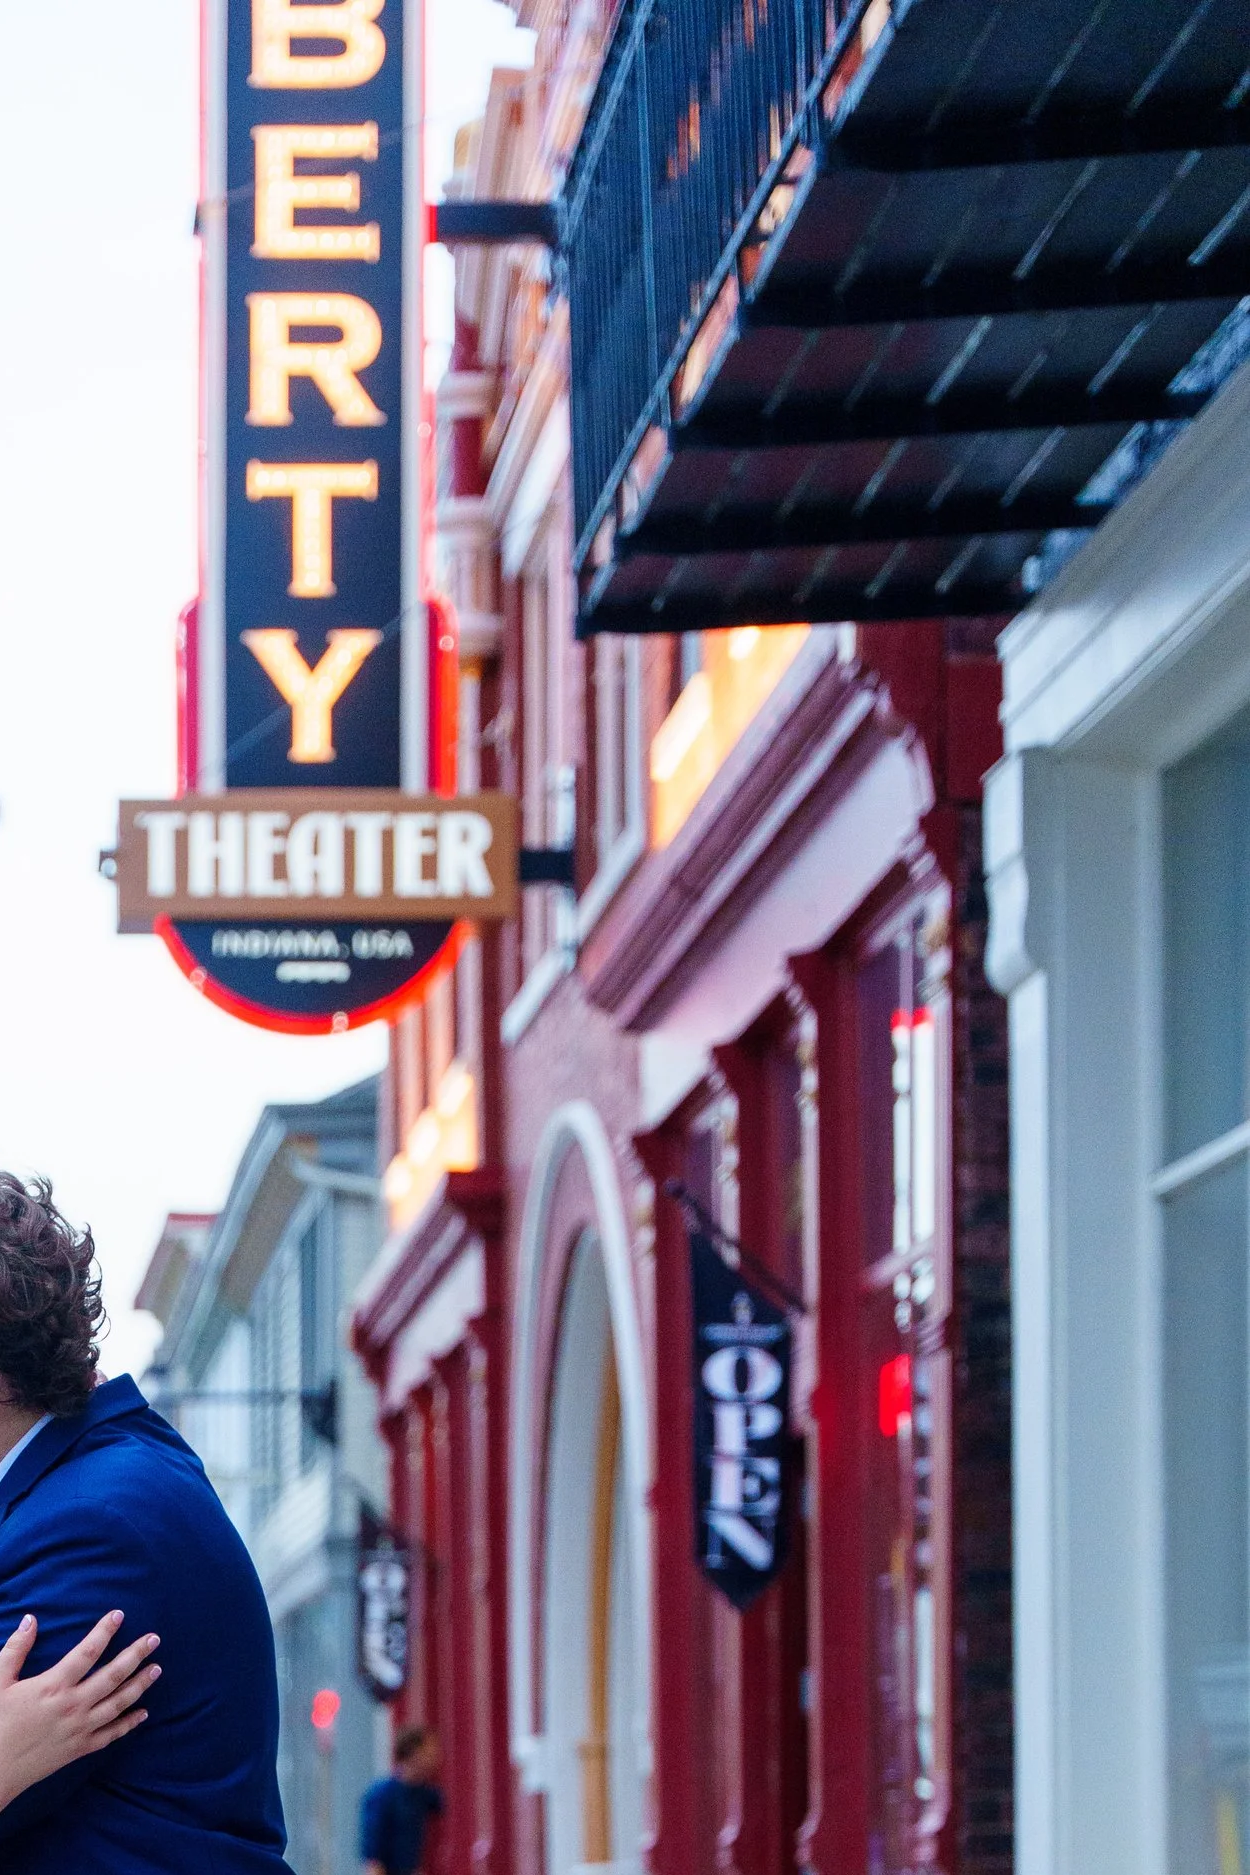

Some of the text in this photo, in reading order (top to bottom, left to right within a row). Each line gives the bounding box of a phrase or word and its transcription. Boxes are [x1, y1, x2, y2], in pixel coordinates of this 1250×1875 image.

[241, 0, 387, 763] BERTY
[135, 810, 494, 898] THEATER
[351, 929, 414, 959] USA
[700, 1345, 784, 1572] OPEN
